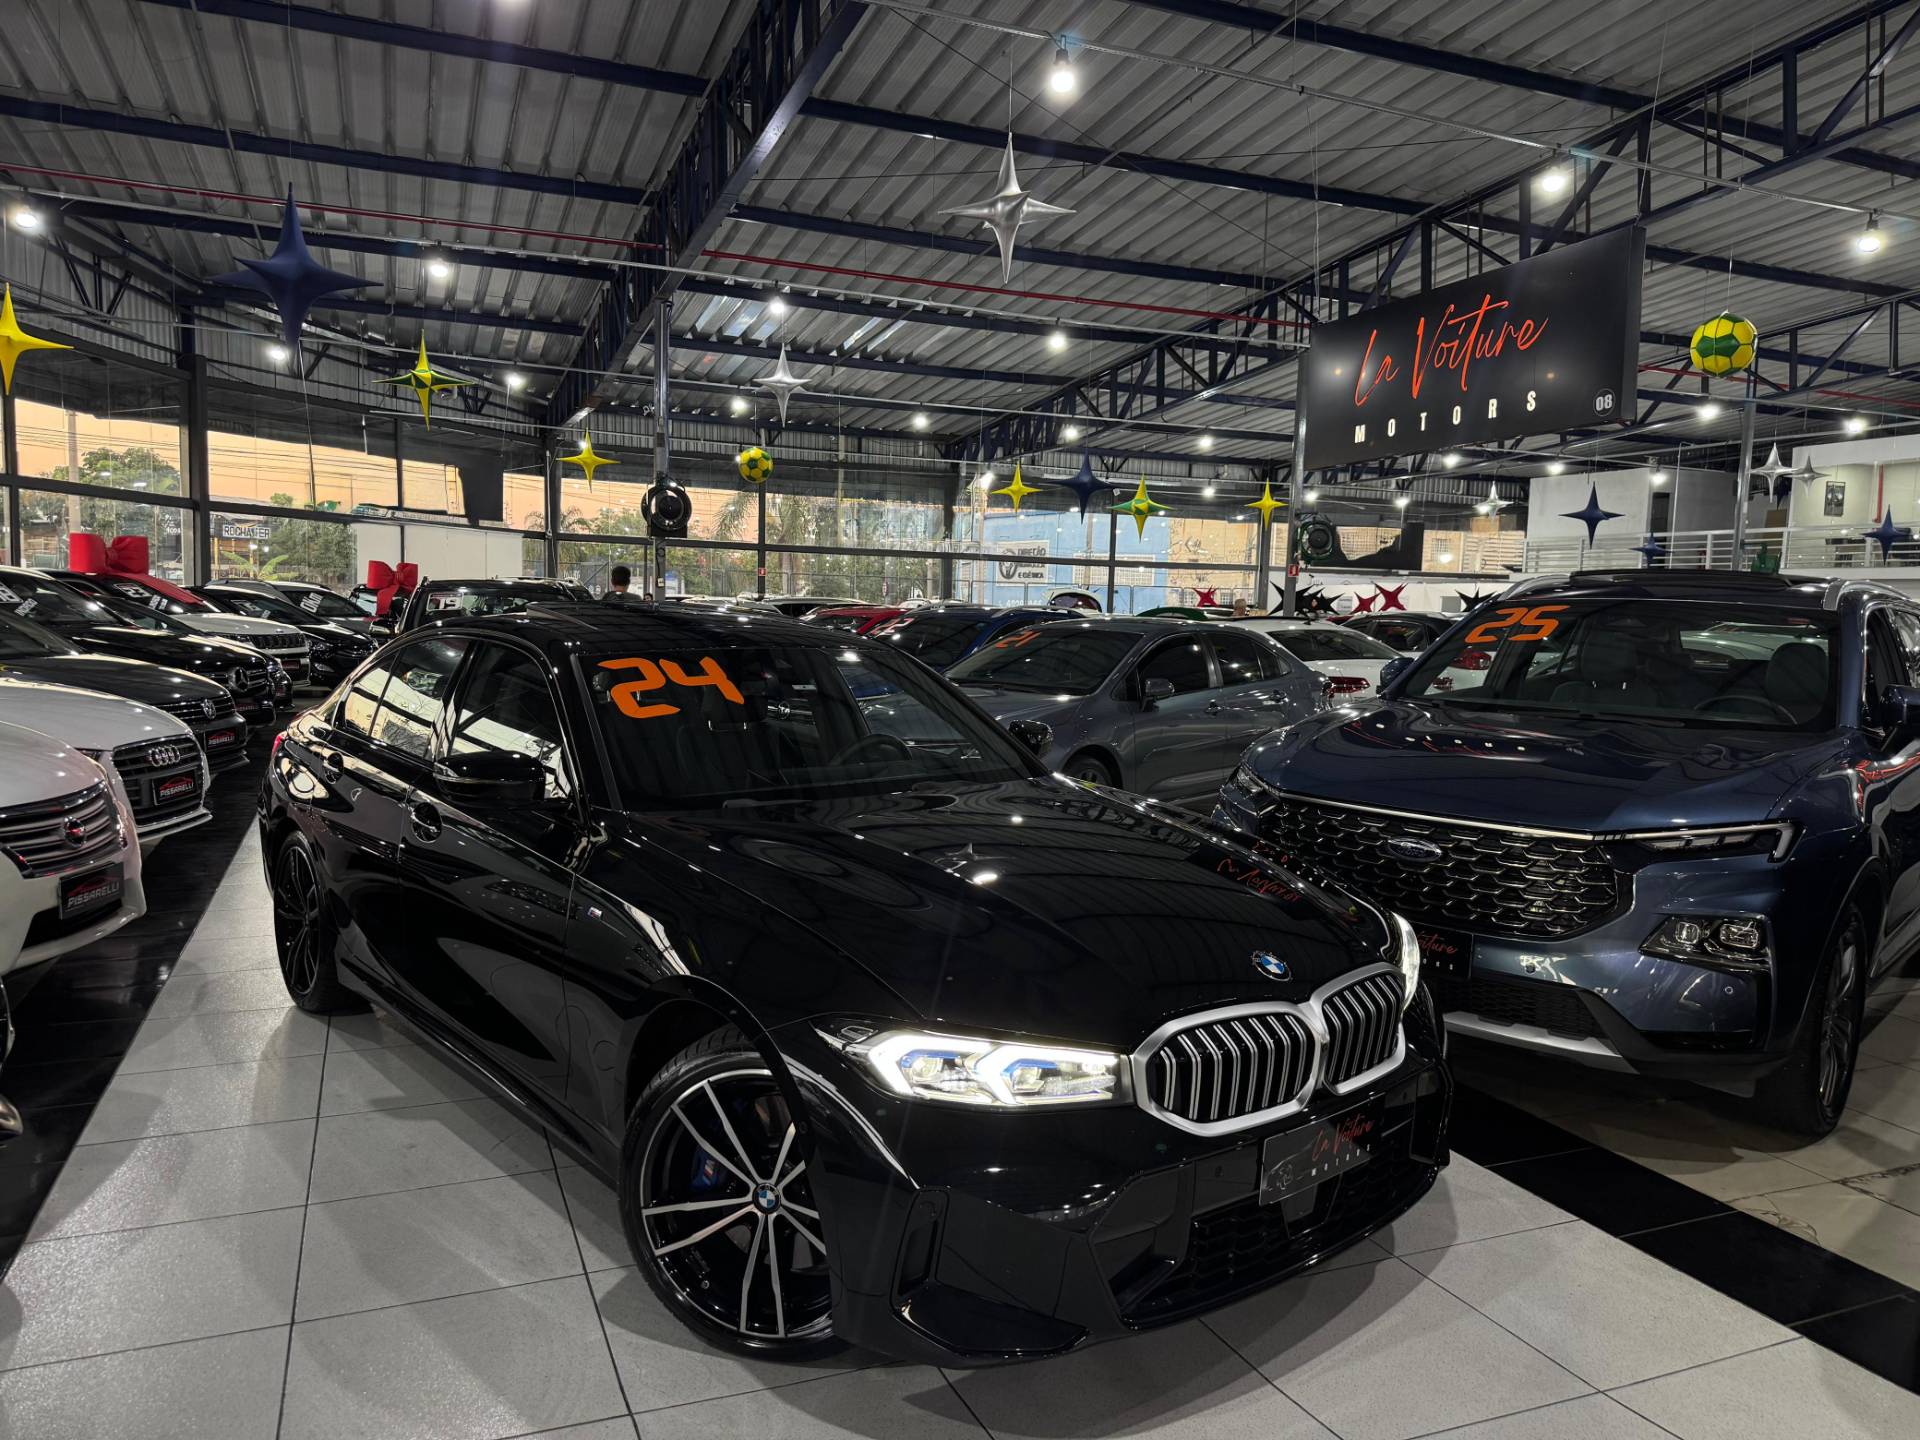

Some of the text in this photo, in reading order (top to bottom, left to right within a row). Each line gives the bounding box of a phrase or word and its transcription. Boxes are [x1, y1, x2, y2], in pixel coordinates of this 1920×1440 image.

[1354, 294, 1549, 407] La Voiture
[1354, 390, 1537, 444] MOTORS
[1595, 394, 1613, 411] 08
[1465, 605, 1570, 644] 25
[598, 656, 745, 719] 24
[160, 781, 194, 797] PISSARELLI
[67, 881, 120, 907] PISSARELLI
